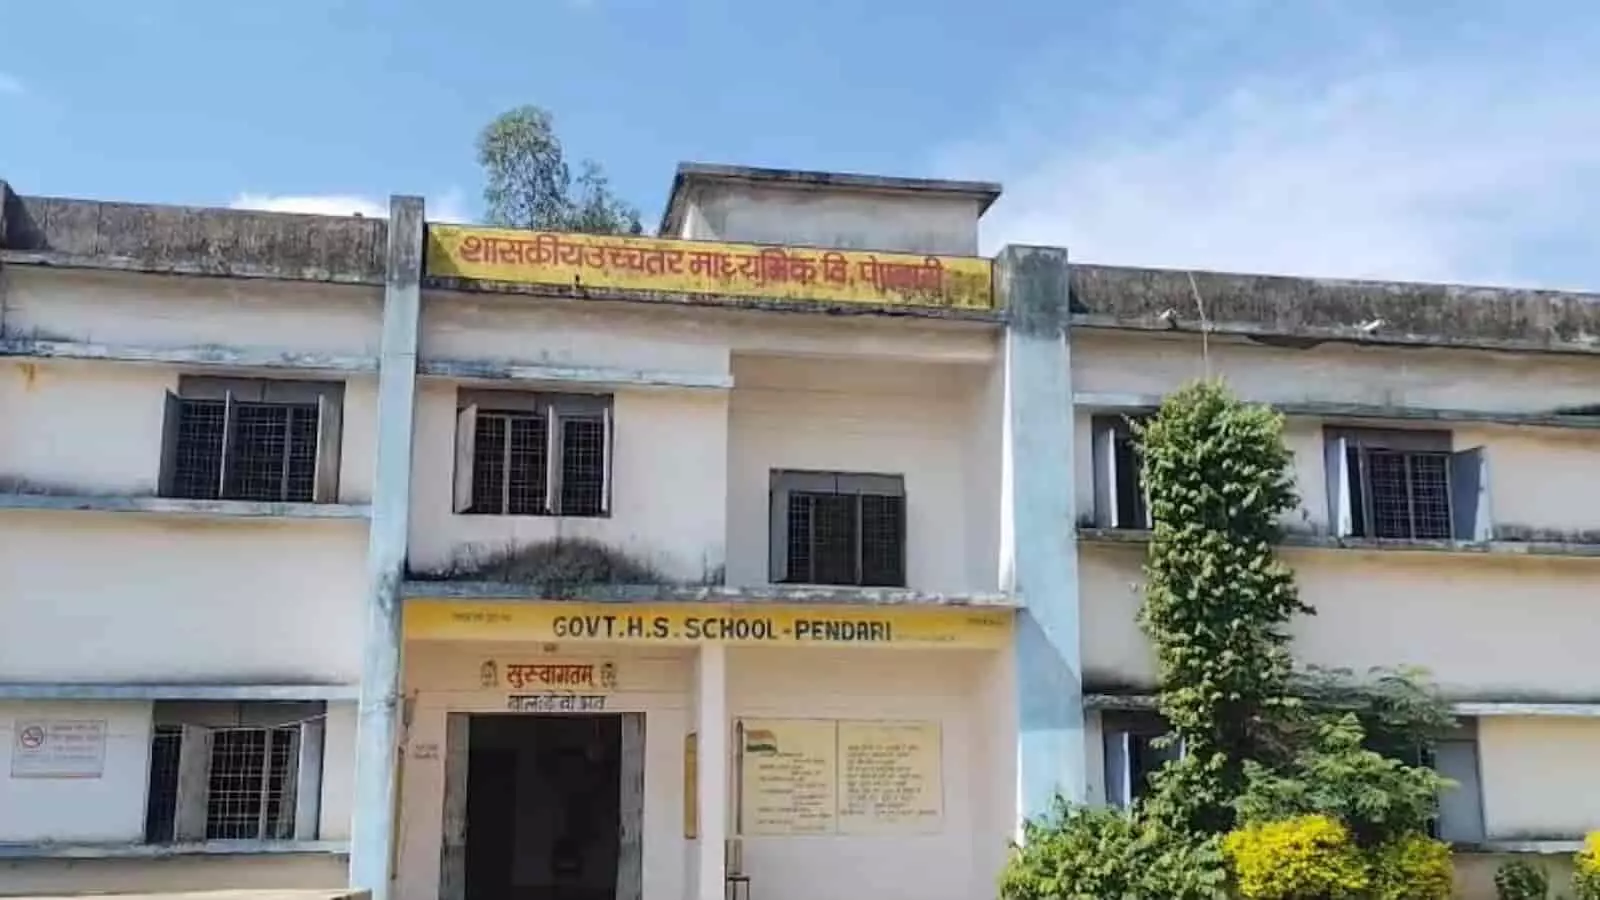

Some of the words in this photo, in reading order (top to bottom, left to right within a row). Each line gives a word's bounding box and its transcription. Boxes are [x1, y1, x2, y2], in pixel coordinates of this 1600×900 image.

[460, 234, 584, 266] शासकीय
[684, 617, 777, 640] SCHOOL
[794, 619, 892, 642] PENDARI
